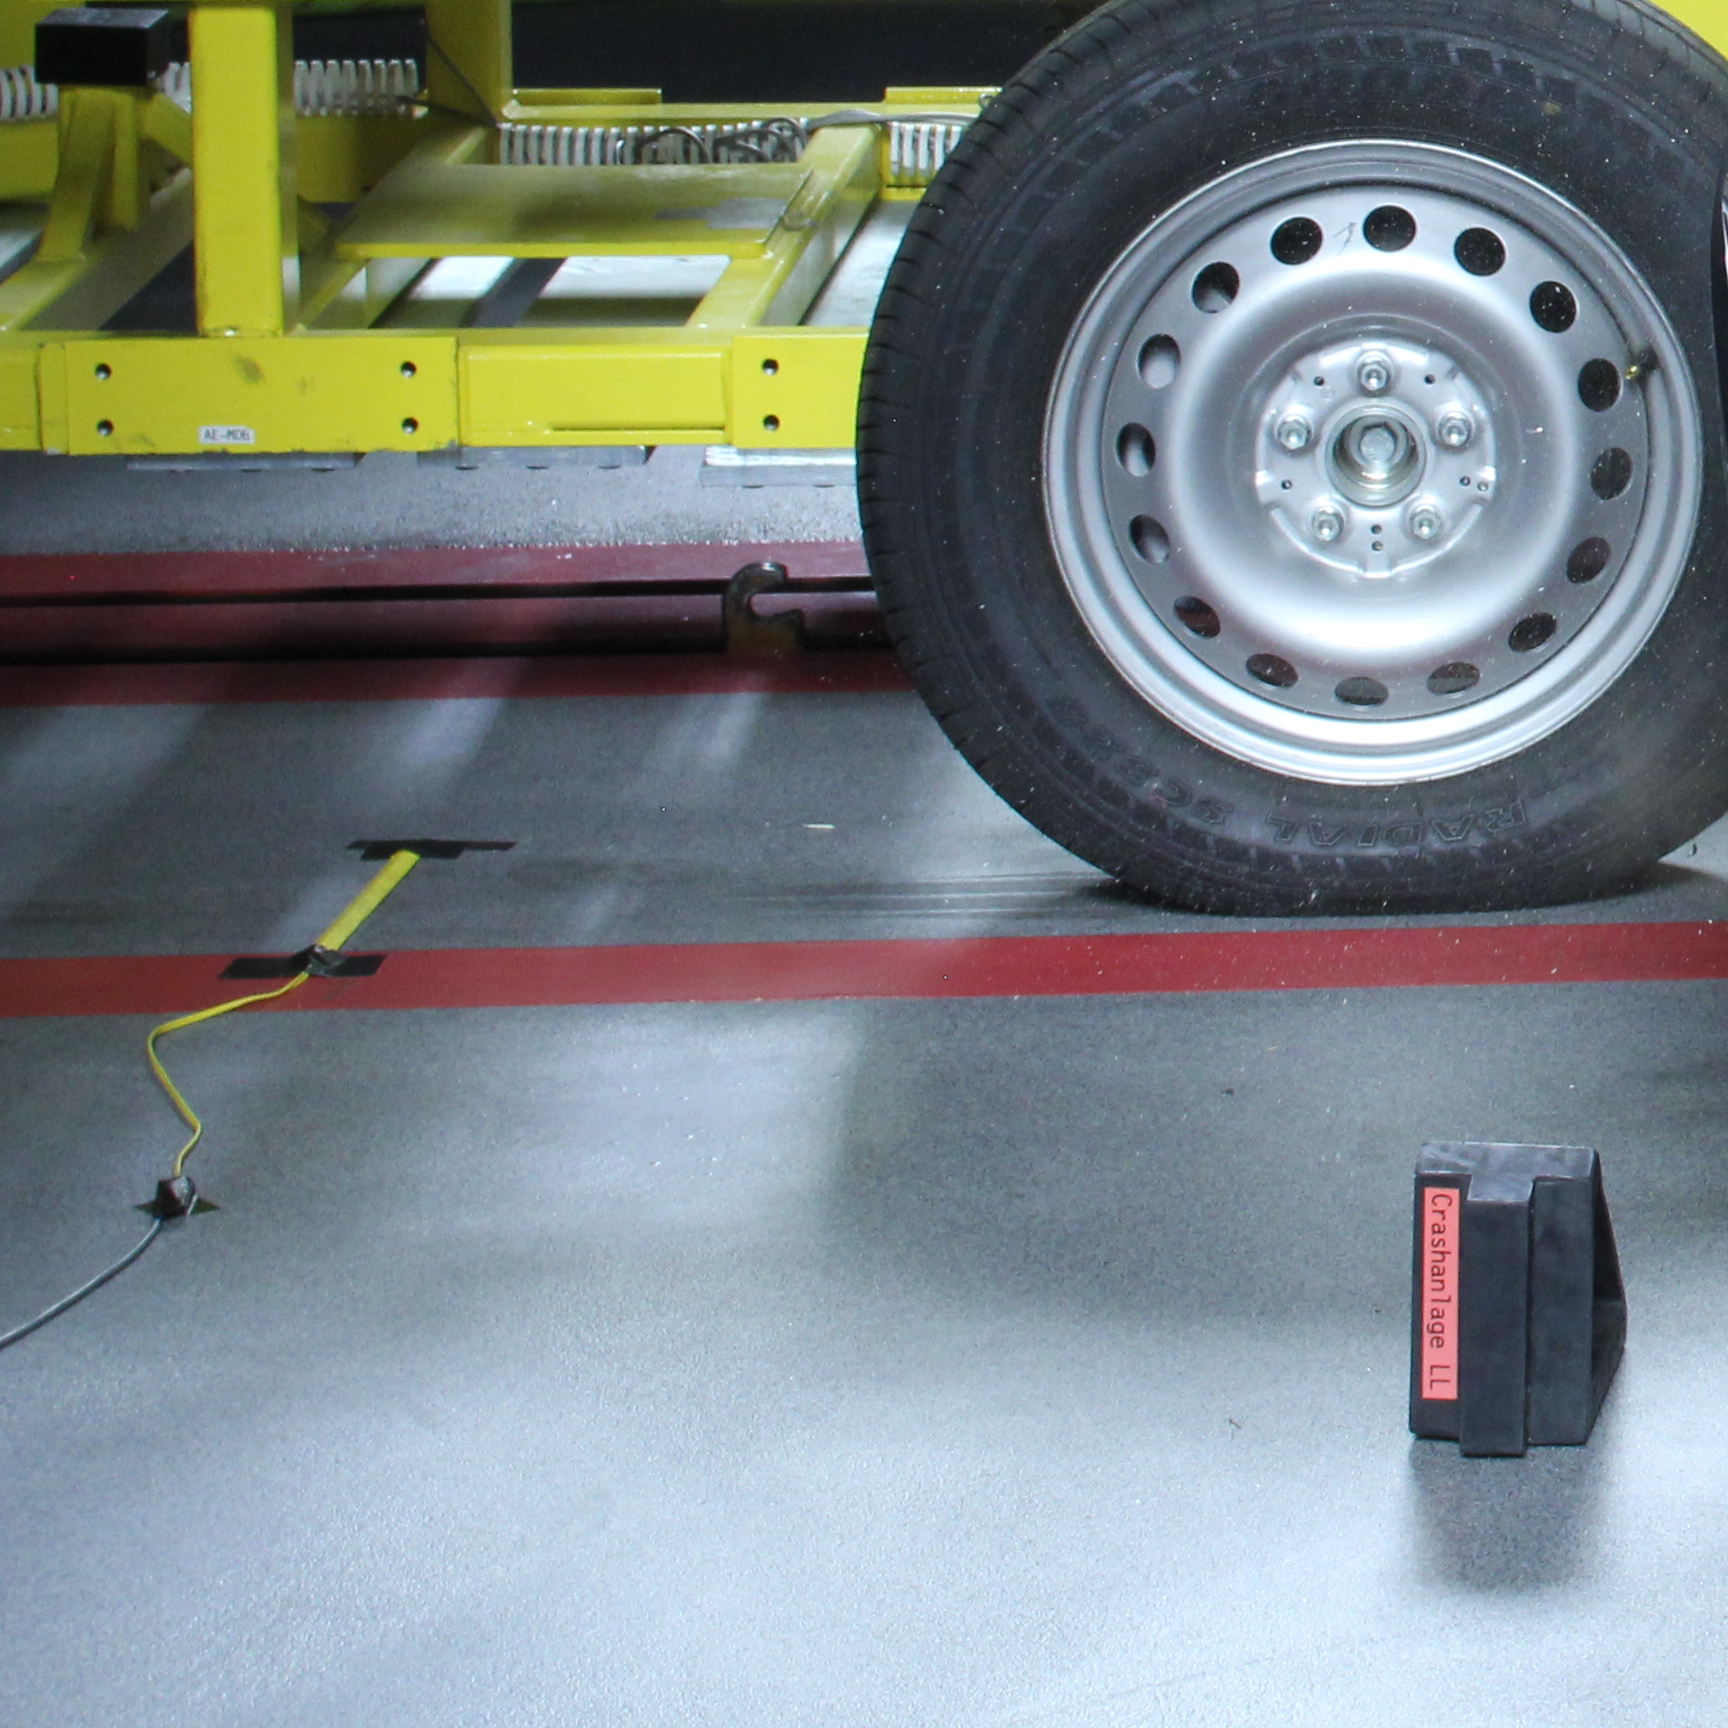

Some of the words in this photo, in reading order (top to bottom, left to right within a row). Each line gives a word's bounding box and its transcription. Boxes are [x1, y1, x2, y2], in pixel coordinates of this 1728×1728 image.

[1263, 796, 1530, 848] RADIAL
[1427, 1193, 1453, 1349] Crashanlage
[1429, 1364, 1451, 1390] LL
